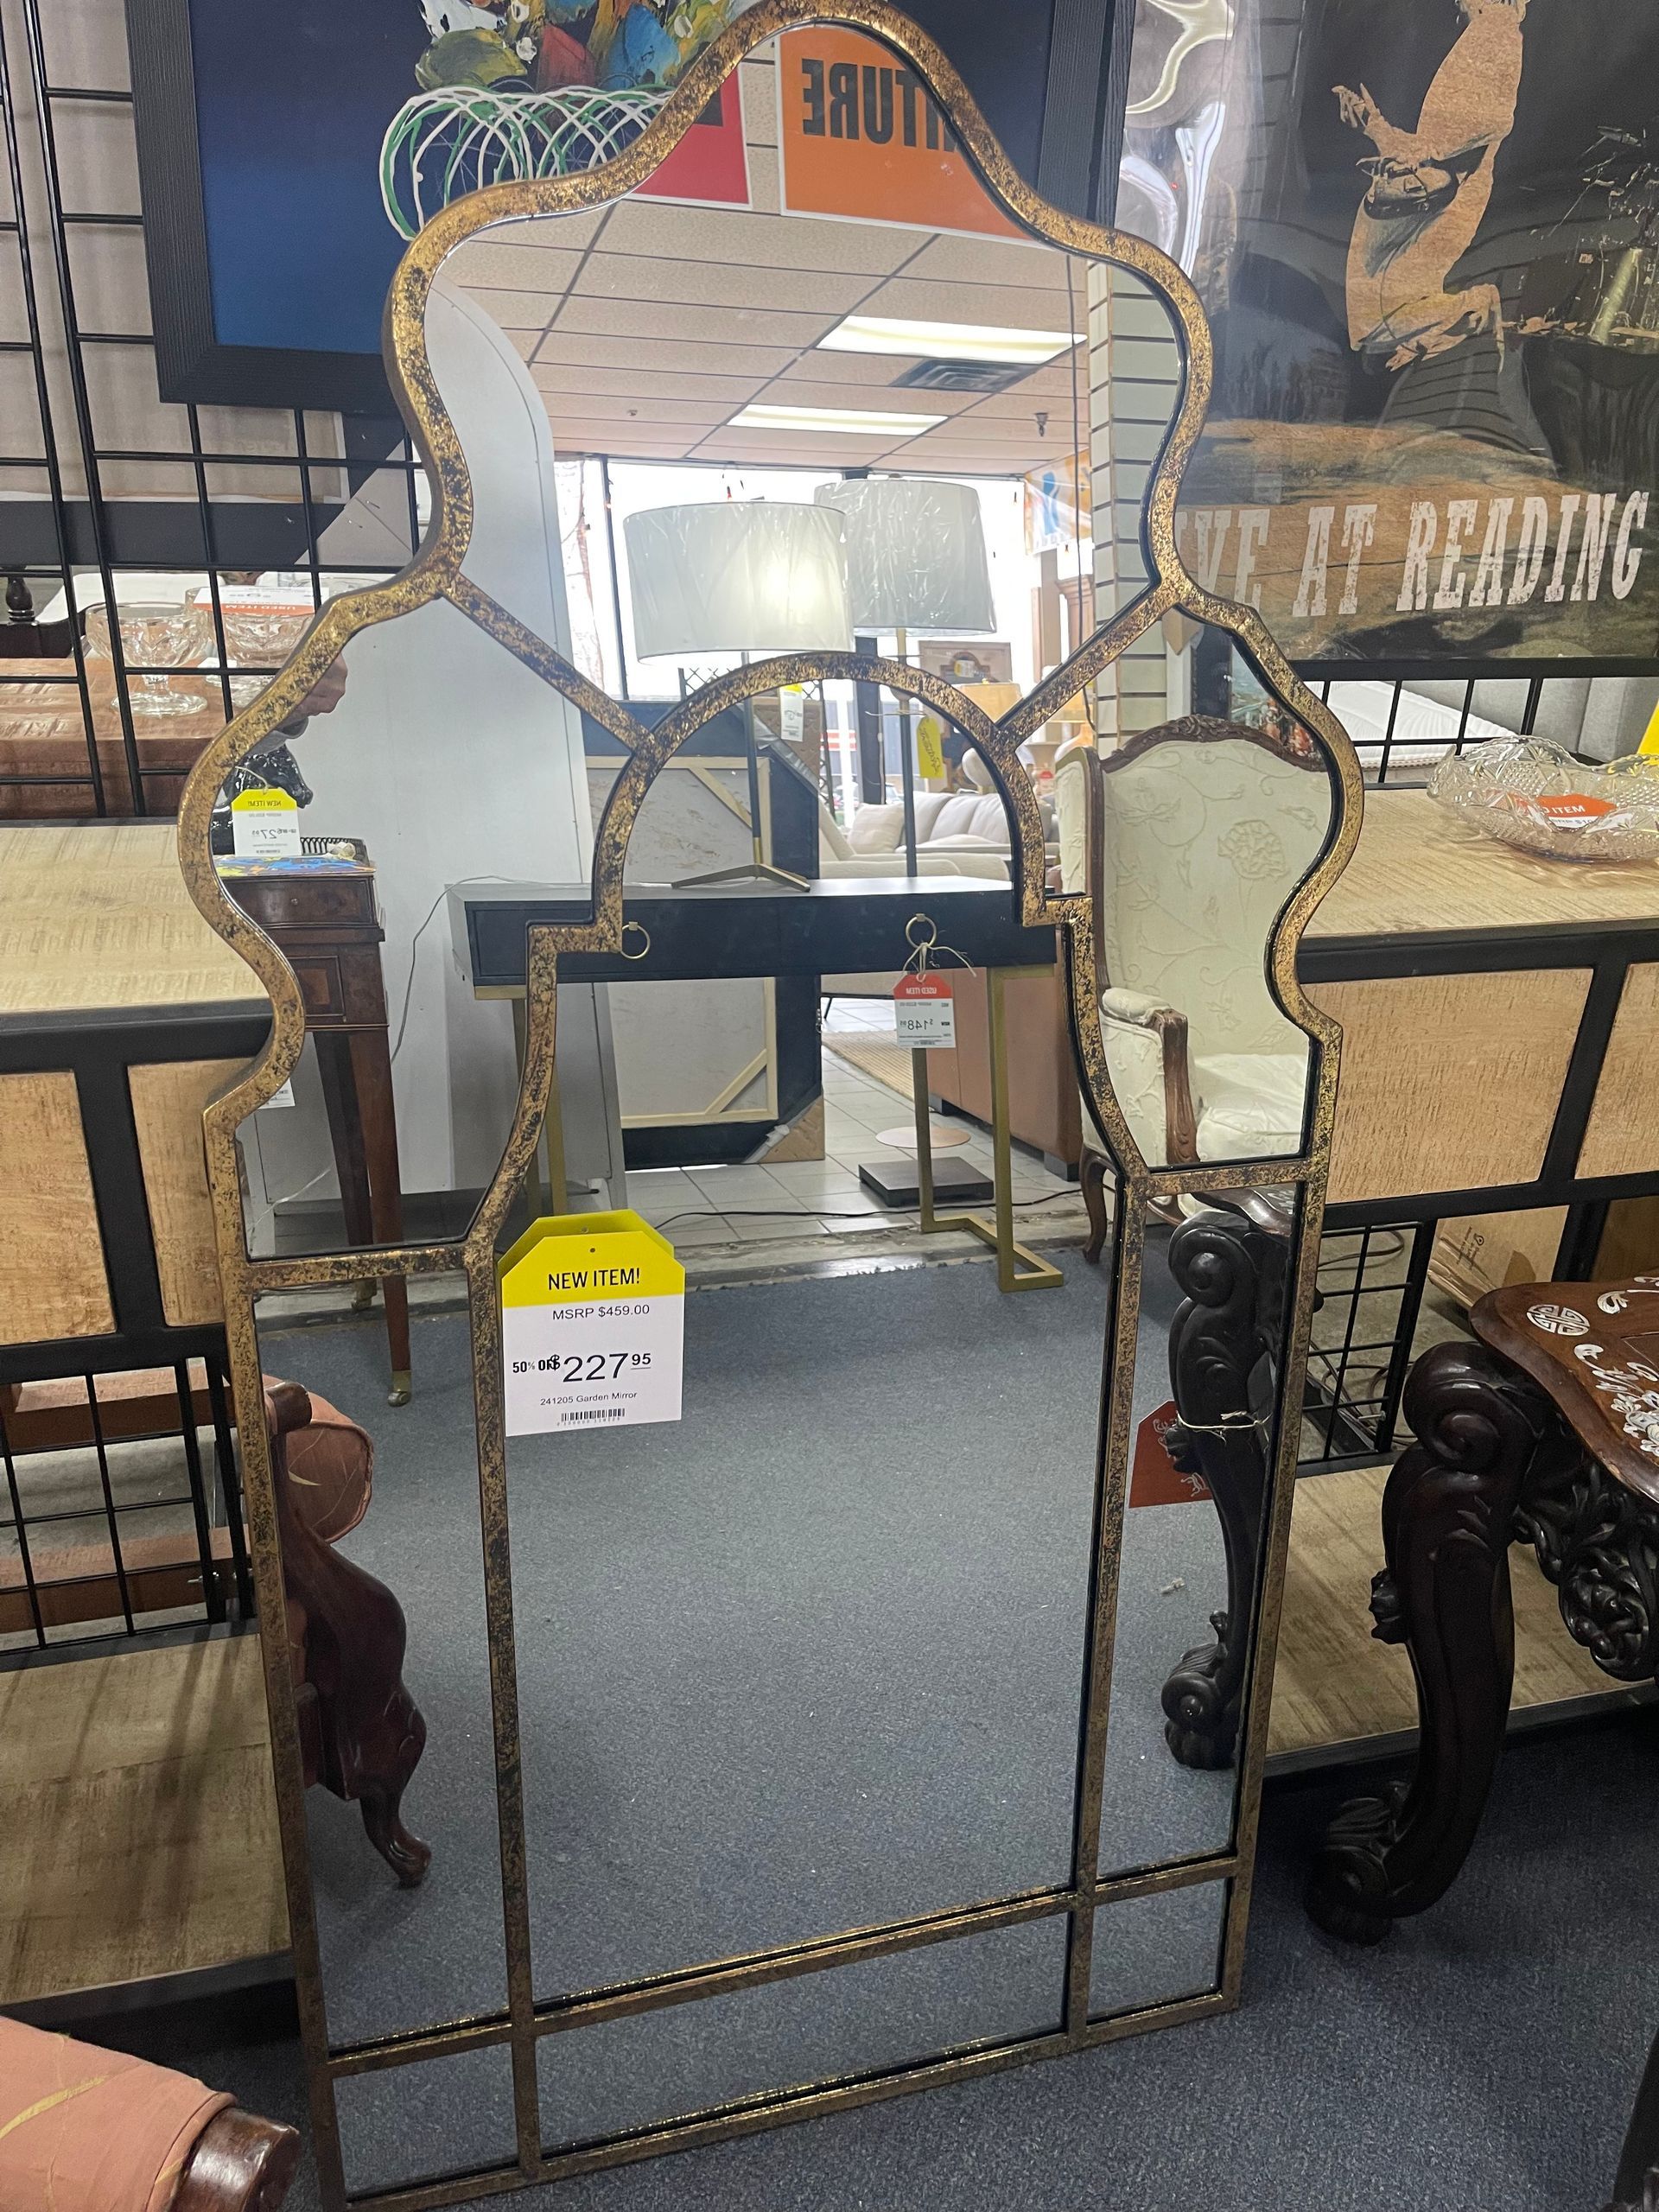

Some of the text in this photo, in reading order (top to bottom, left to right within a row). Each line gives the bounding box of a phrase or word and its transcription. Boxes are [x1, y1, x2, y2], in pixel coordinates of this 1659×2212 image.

[1293, 504, 1377, 617] AT
[1395, 491, 1649, 612] READING
[1552, 804, 1586, 814] ITEM
[548, 1268, 640, 1291] NEW ITEM!
[552, 1304, 650, 1320] MSRP $459.00
[512, 1361, 535, 1373] 50%
[540, 1395, 574, 1406] 241205
[576, 1393, 609, 1402] Garden
